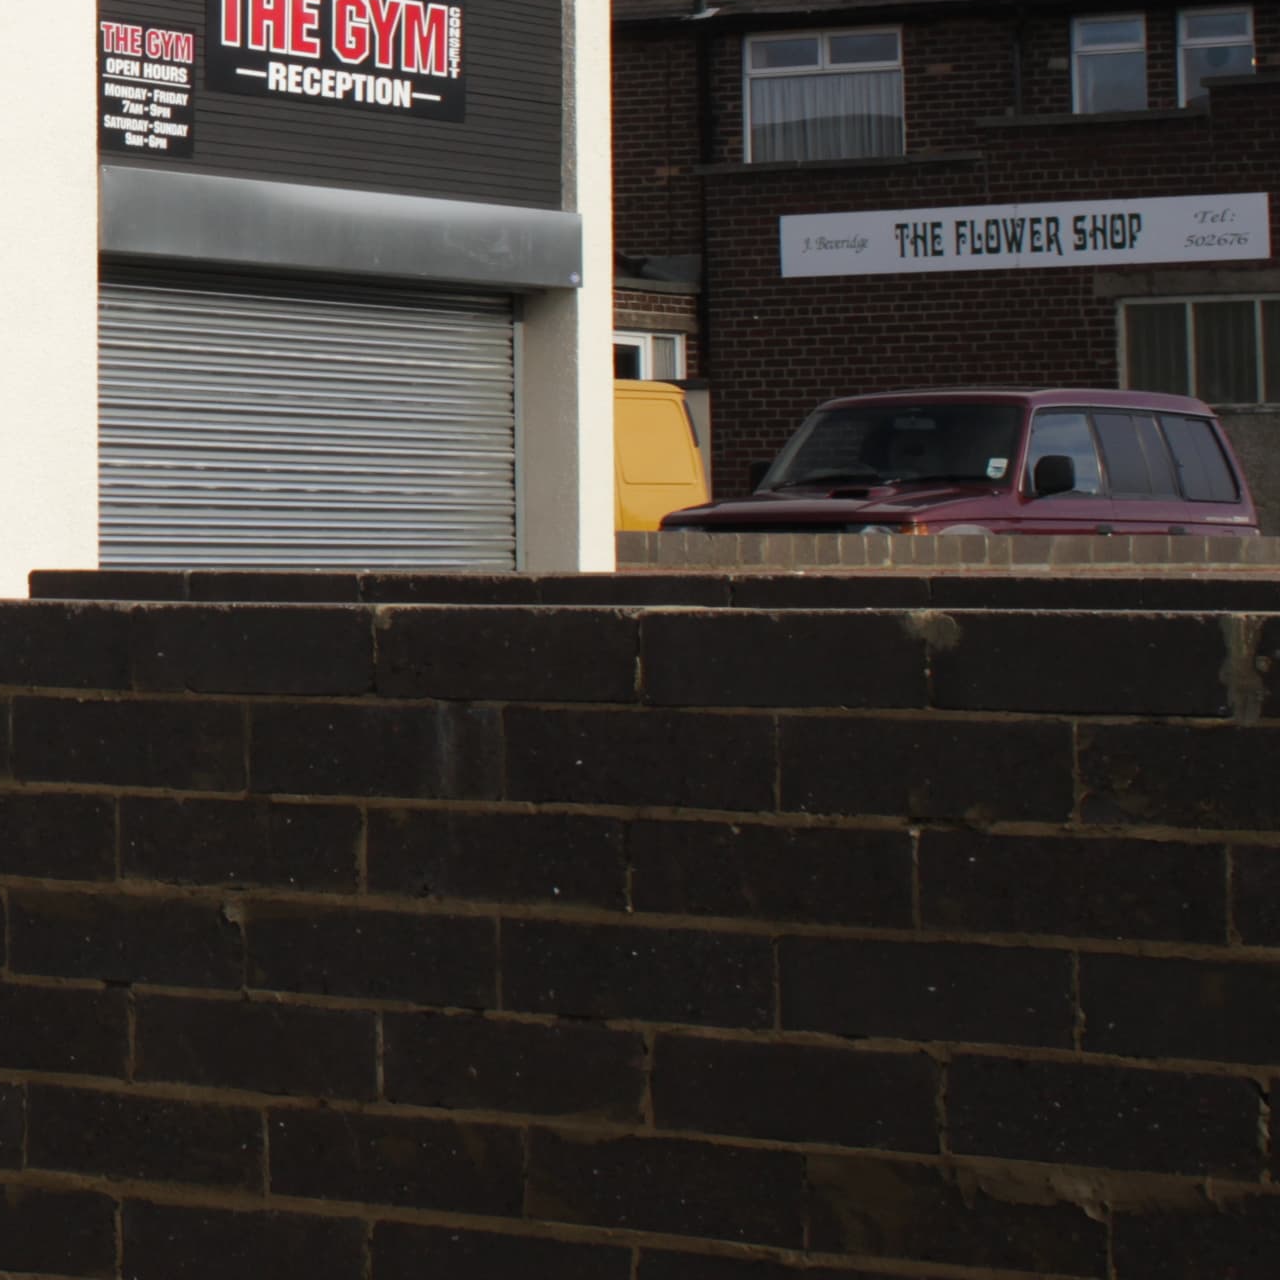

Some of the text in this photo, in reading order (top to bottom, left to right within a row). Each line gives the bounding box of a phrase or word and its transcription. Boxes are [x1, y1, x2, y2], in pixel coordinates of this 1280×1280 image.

[100, 21, 193, 63] THE GYM
[448, 6, 461, 79] CONSETT
[106, 58, 188, 83] OPEN HOURS
[268, 61, 412, 108] RECEPTION
[895, 212, 1142, 258] THE FLOWER SHOP
[1183, 231, 1251, 248] 502676
